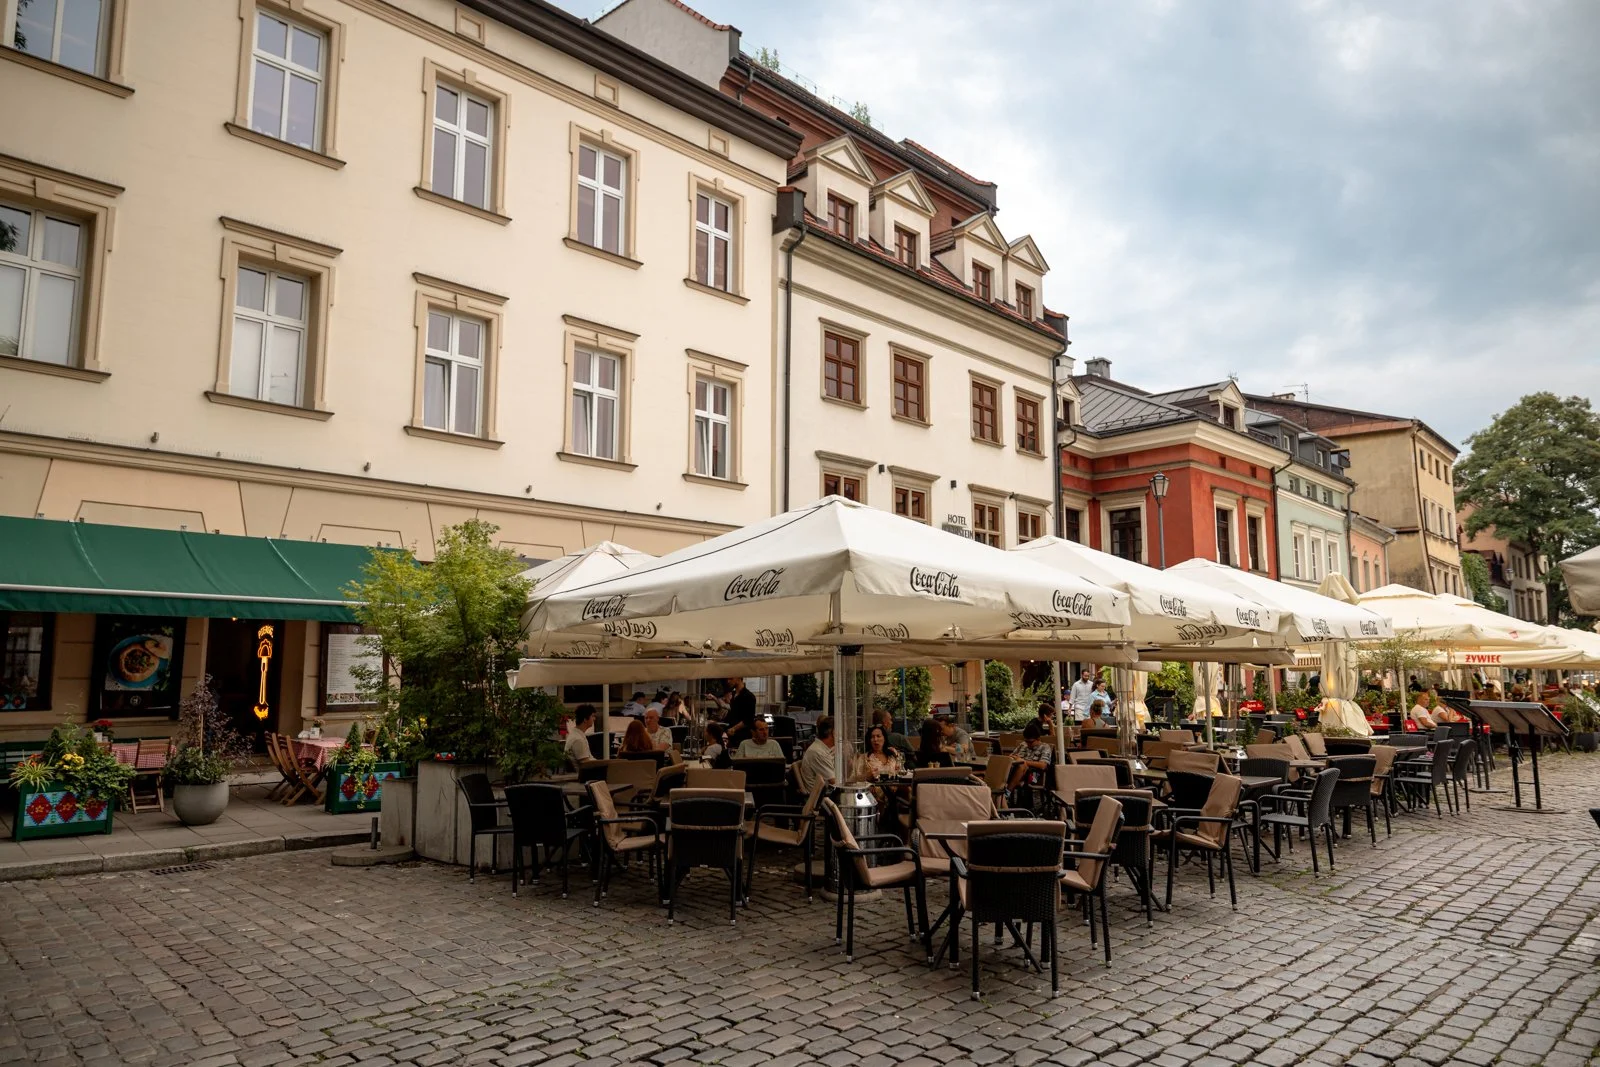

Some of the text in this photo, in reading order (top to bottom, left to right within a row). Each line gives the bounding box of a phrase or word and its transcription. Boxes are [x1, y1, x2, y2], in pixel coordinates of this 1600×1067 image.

[948, 514, 967, 526] HOTEL
[724, 567, 785, 601] Coca-Cola
[910, 566, 960, 599] Coca-Cola
[582, 594, 628, 621] Coca-Cola
[1052, 589, 1092, 616] Coca-Cola
[1160, 594, 1187, 617] Coca-Cola
[1236, 607, 1261, 627] Coca-Cola
